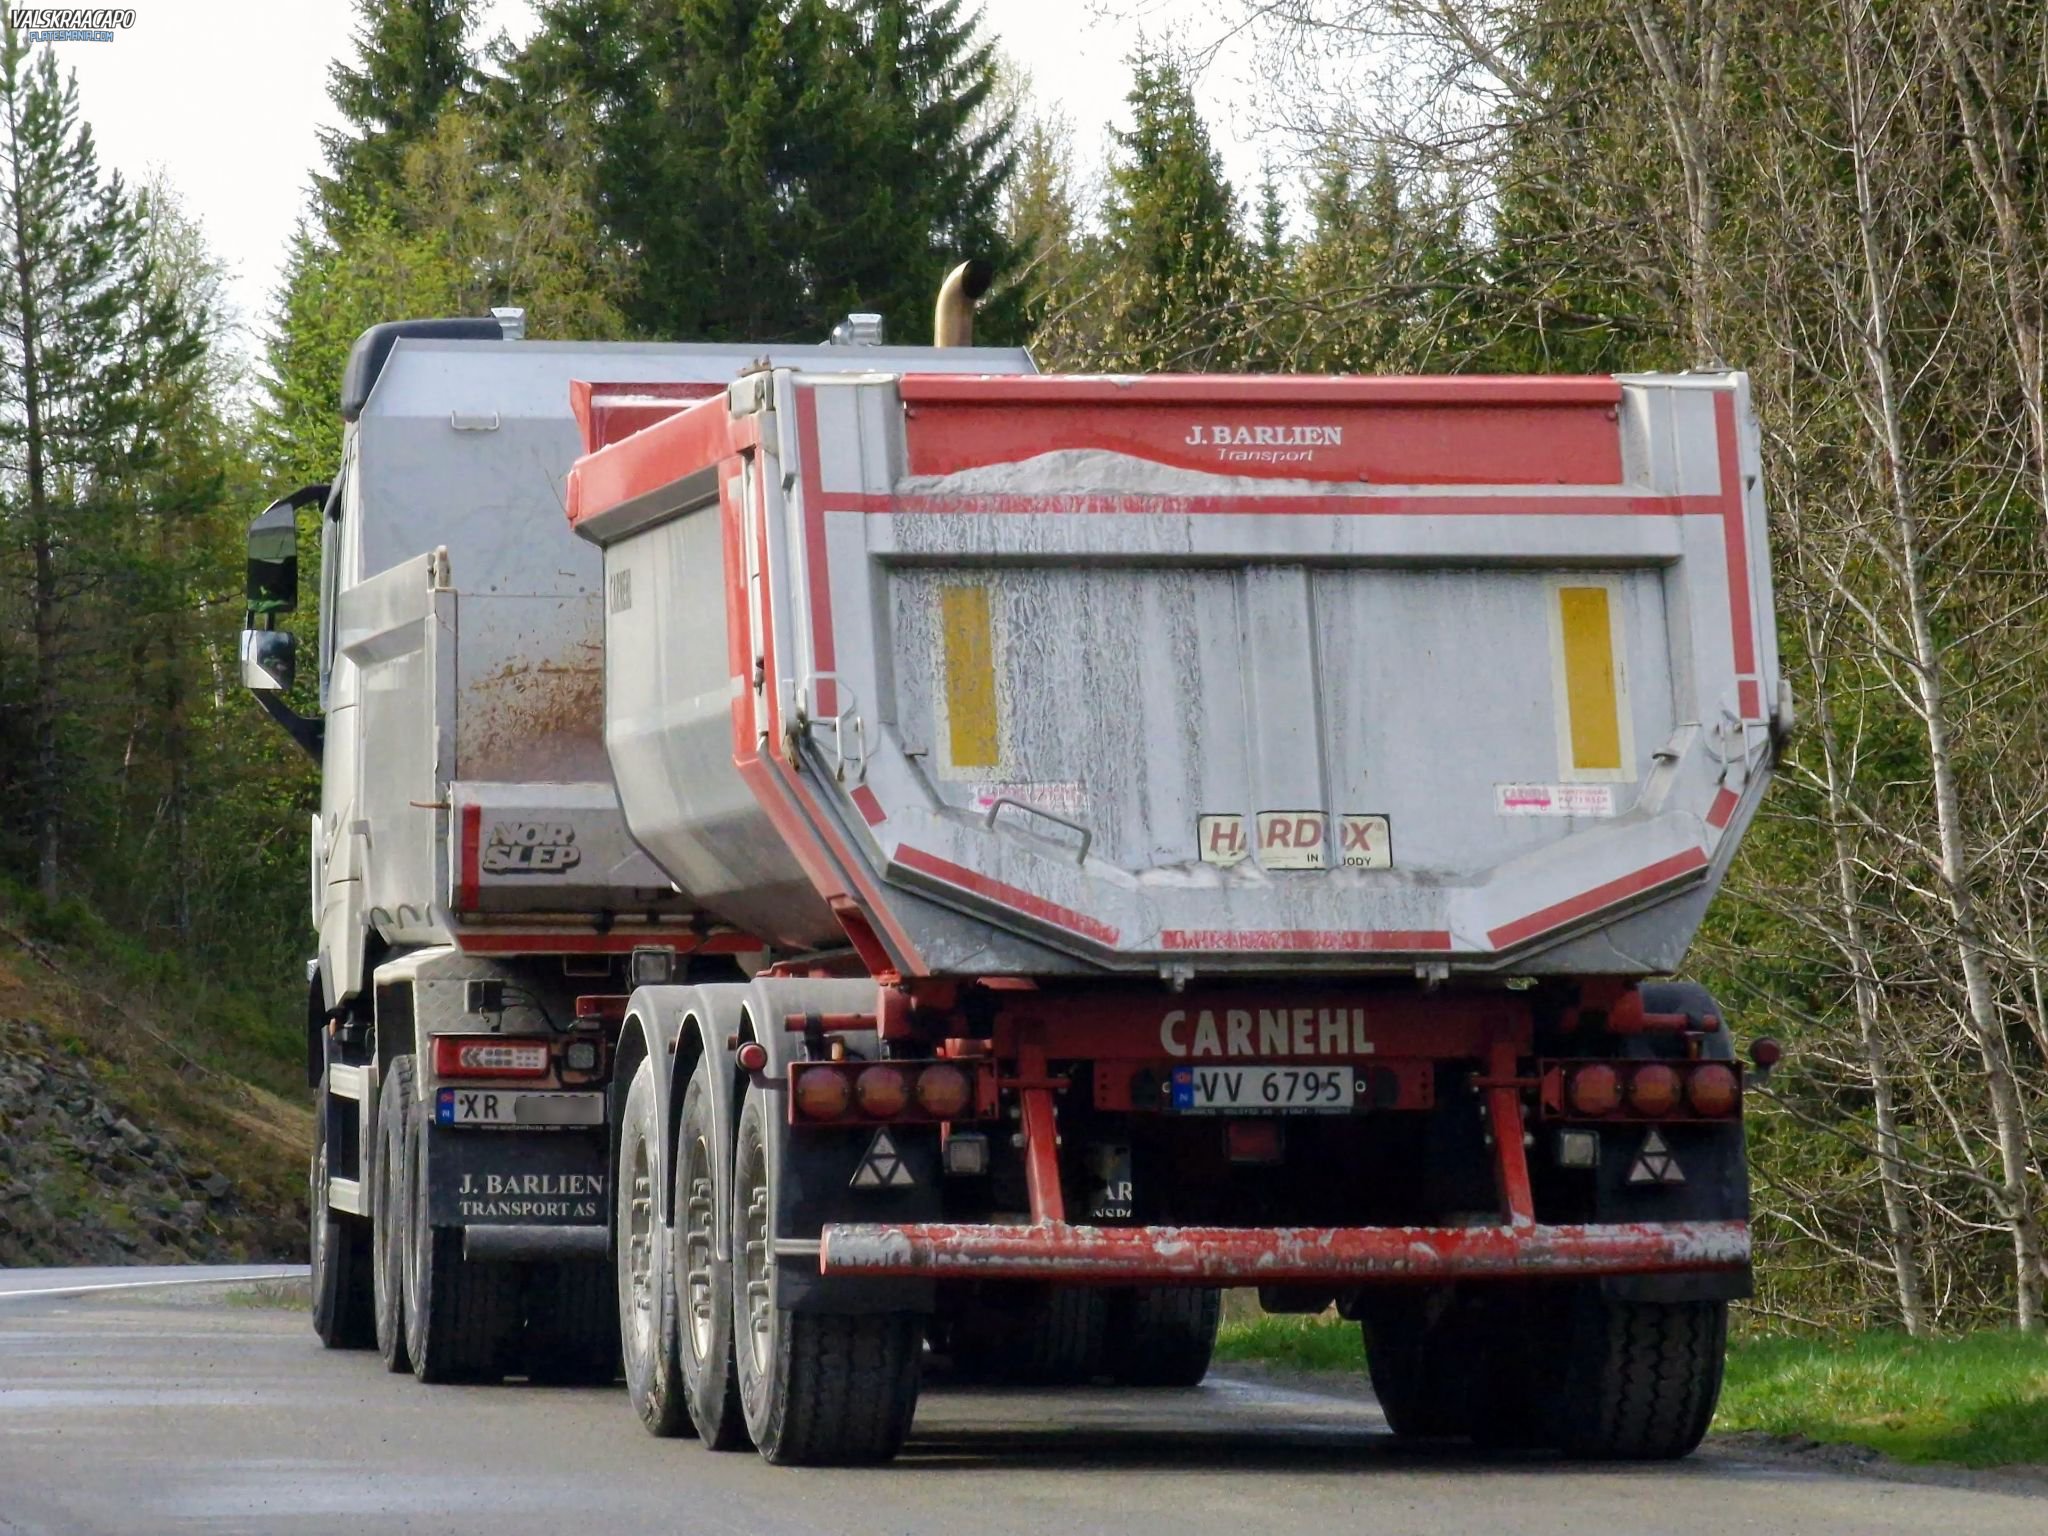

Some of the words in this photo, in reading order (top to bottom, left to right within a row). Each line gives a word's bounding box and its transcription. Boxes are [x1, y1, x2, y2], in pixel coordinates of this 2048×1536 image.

[1185, 426, 1207, 445] J.
[1212, 426, 1343, 445] BARLIEN
[1218, 448, 1313, 464] Transport
[490, 822, 576, 847] NOR
[482, 845, 581, 875] SLEP
[1306, 853, 1319, 863] IN
[1160, 1008, 1376, 1057] CARNEHL
[1200, 1071, 1243, 1102] VV
[1261, 1071, 1342, 1102] 6795
[459, 1174, 478, 1195] J.
[487, 1174, 604, 1195] BARLIEN
[459, 1201, 571, 1217] TRANSPORT
[573, 1202, 596, 1217] AS
